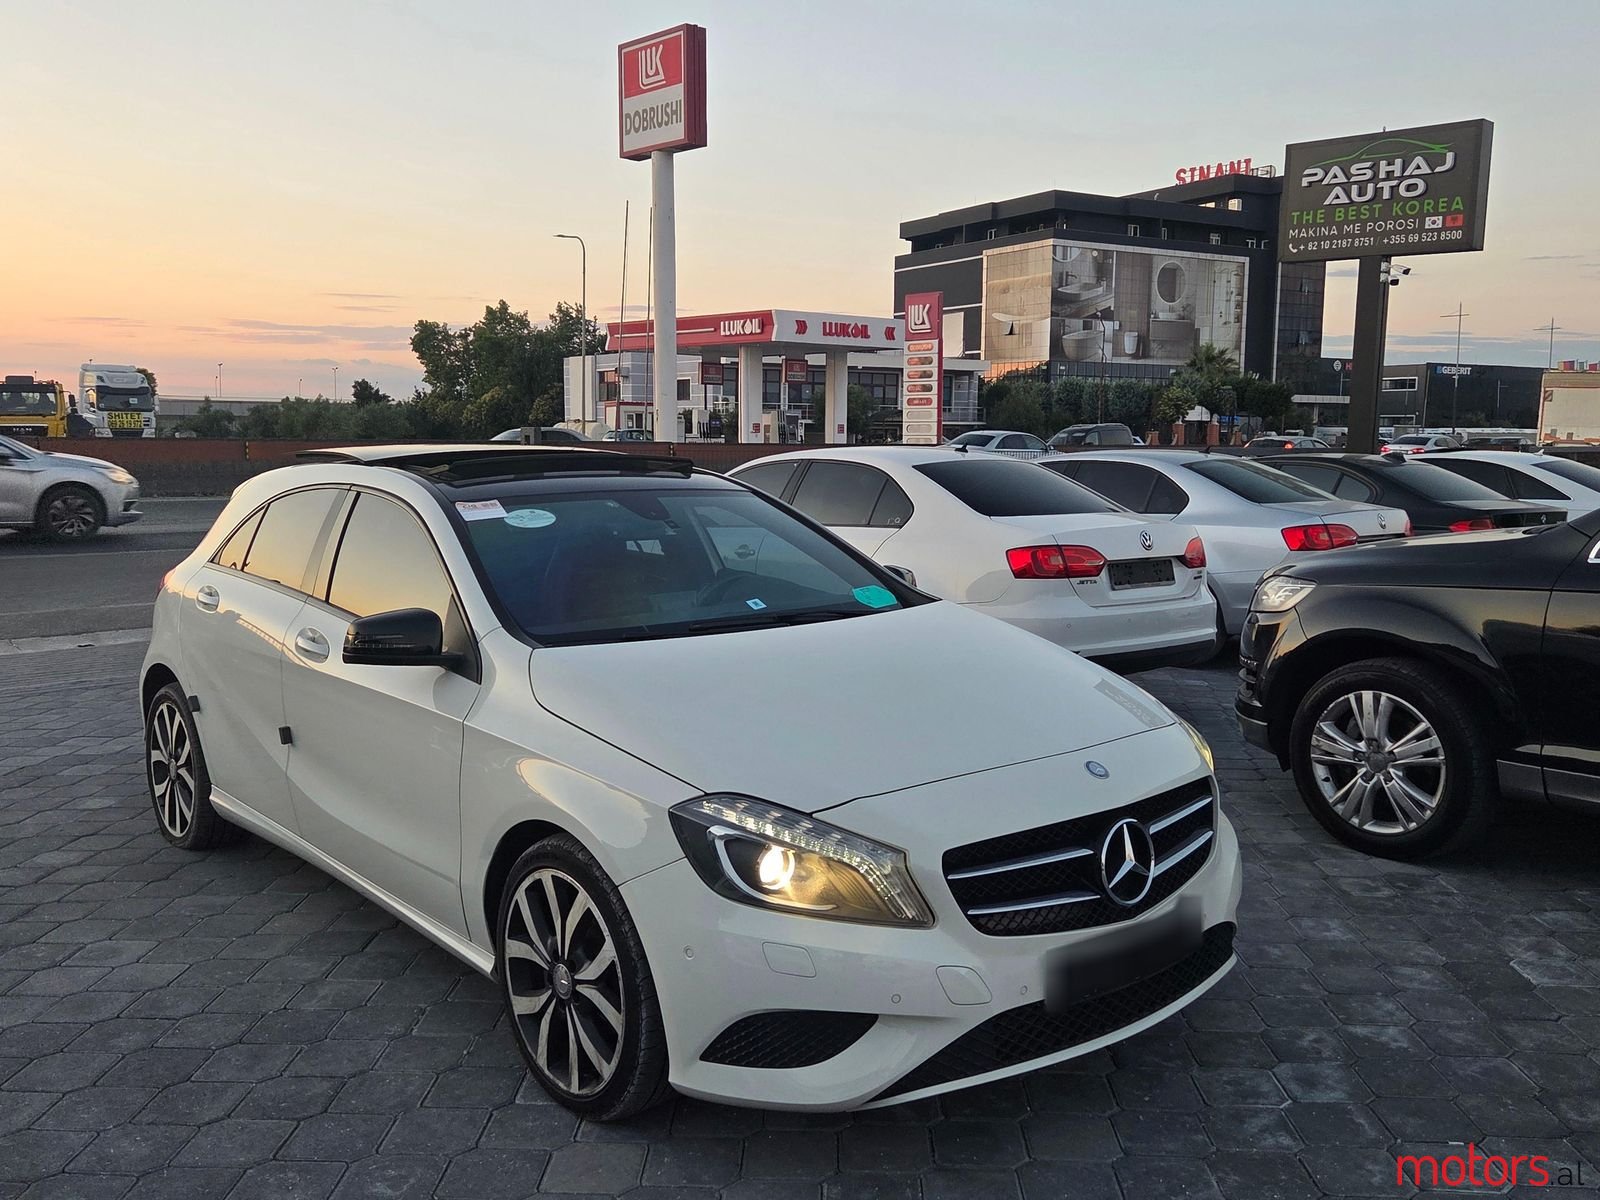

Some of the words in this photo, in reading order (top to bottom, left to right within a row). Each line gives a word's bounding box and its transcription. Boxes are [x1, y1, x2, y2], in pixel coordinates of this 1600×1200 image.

[624, 99, 682, 136] DOBRUSHI
[1302, 151, 1456, 187] PASHAJ
[1323, 178, 1427, 205] AUTO
[1291, 210, 1326, 225] THE
[1335, 204, 1383, 222] BEST
[1393, 196, 1464, 216] KOREA
[1288, 225, 1338, 239] MAKINA
[1343, 223, 1361, 235] ME
[1366, 218, 1419, 233] POROSI
[1308, 242, 1318, 251] 82
[1320, 241, 1330, 250] 10
[1331, 239, 1352, 249] 2187
[1354, 237, 1375, 247] 8751
[1408, 232, 1419, 243] 69
[1421, 231, 1438, 242] 523
[1440, 229, 1463, 241] 8500
[108, 412, 142, 420] SHITET
